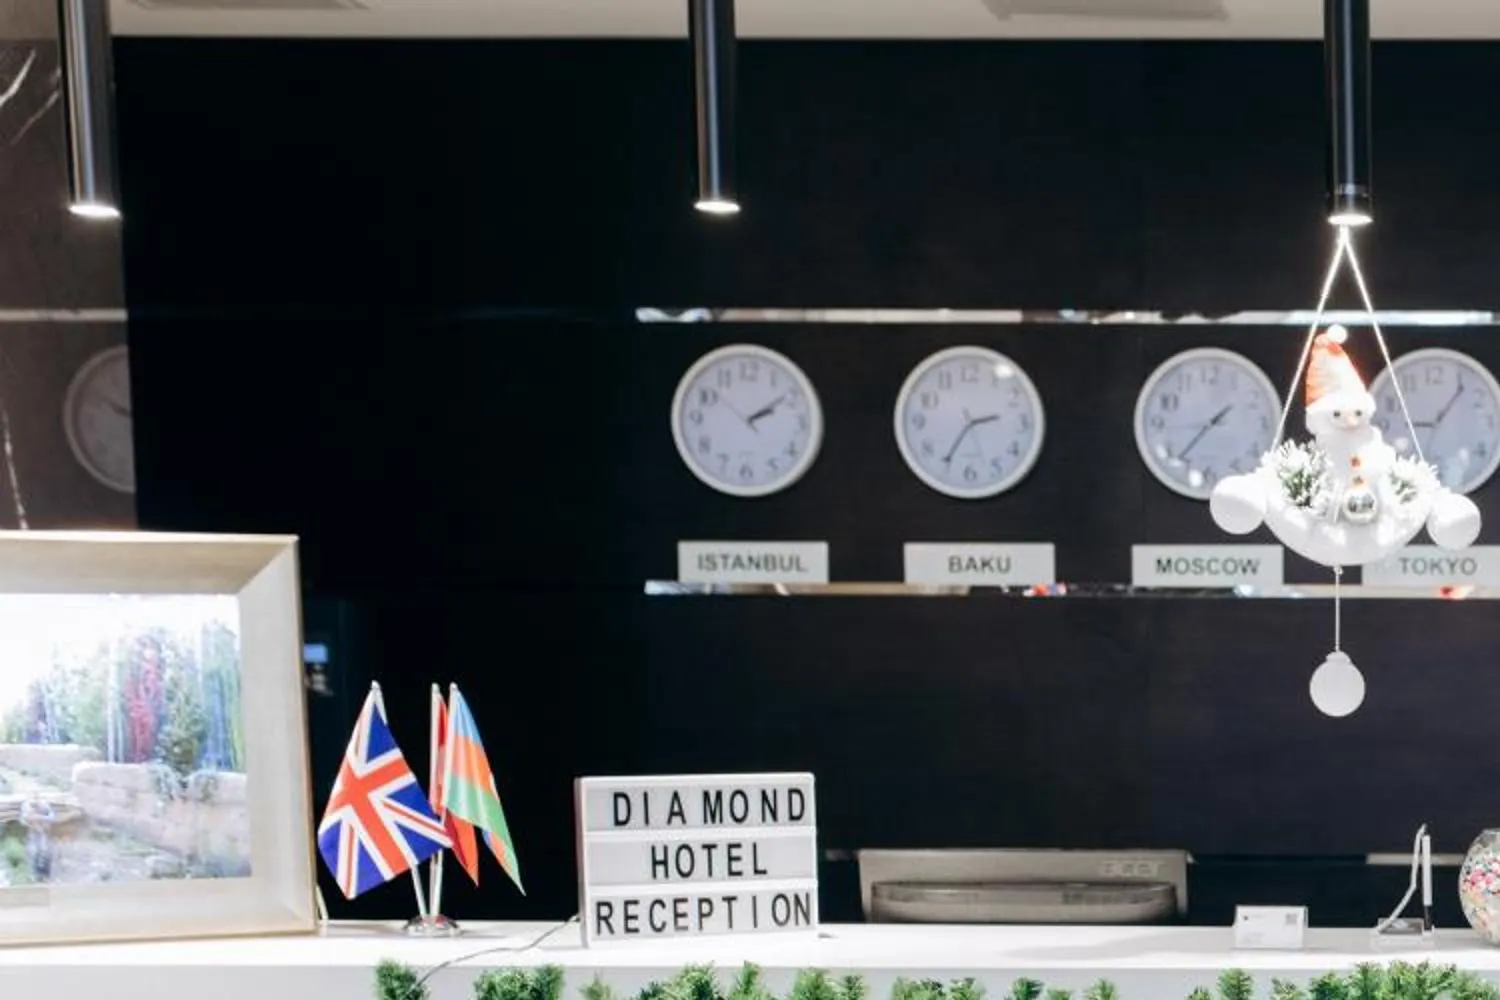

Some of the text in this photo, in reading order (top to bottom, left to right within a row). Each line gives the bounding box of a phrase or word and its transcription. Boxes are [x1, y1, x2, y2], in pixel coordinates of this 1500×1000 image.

[697, 552, 809, 573] ISTANBUL
[948, 555, 1011, 574] BAKU
[1155, 557, 1260, 575] MOSCOW
[1399, 557, 1477, 576] TOKYO
[613, 788, 805, 827] DIAMOND
[651, 842, 767, 880] HOTEL
[1101, 861, 1166, 878] acer
[597, 893, 811, 936] RECEPTION
